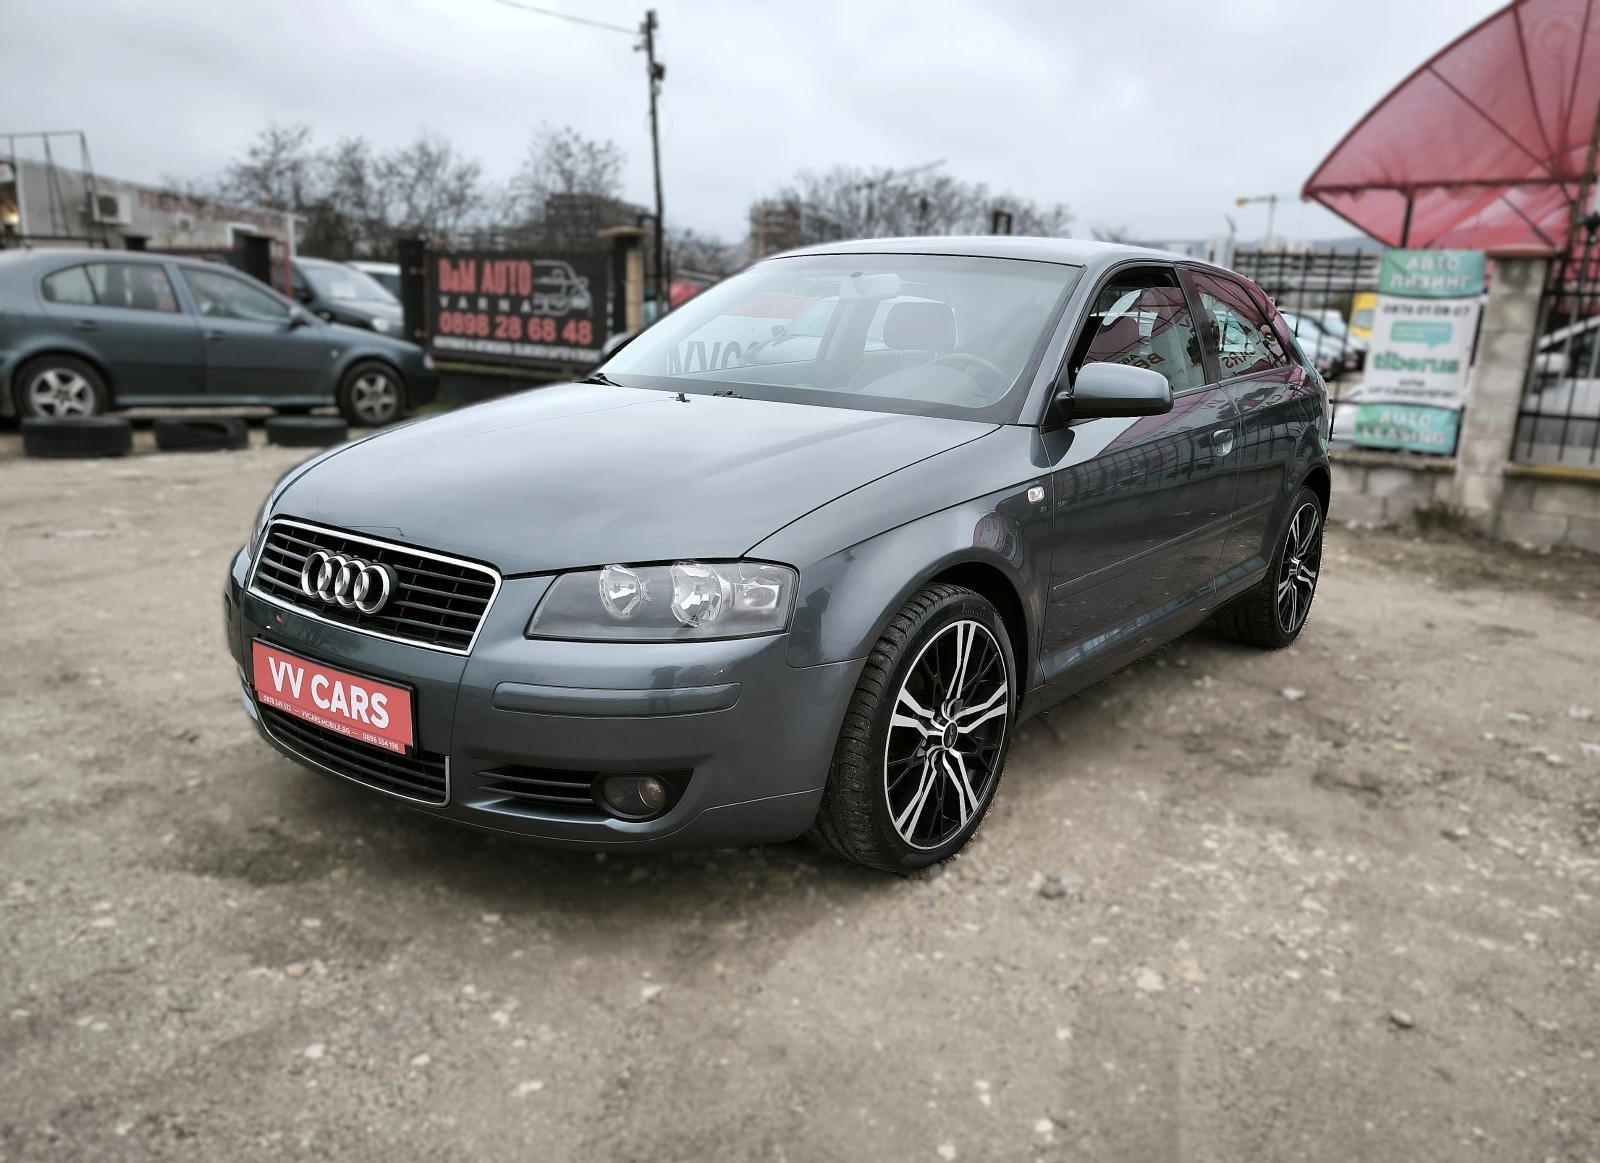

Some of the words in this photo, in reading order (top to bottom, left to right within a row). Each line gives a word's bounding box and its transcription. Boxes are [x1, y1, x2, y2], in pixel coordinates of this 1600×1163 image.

[1406, 255, 1460, 273] АВТО
[481, 259, 532, 297] AUTO
[1389, 273, 1474, 291] ЛИЗИНГ
[438, 295, 533, 314] VARNA
[438, 310, 490, 338] 0898
[494, 315, 523, 341] 28
[527, 317, 557, 343] 68
[562, 319, 594, 346] 48
[1373, 350, 1460, 375] tiberus
[1378, 410, 1433, 428] AUTO
[1361, 425, 1446, 445] LEASING
[268, 656, 304, 699] VV
[311, 674, 389, 729] CARS
